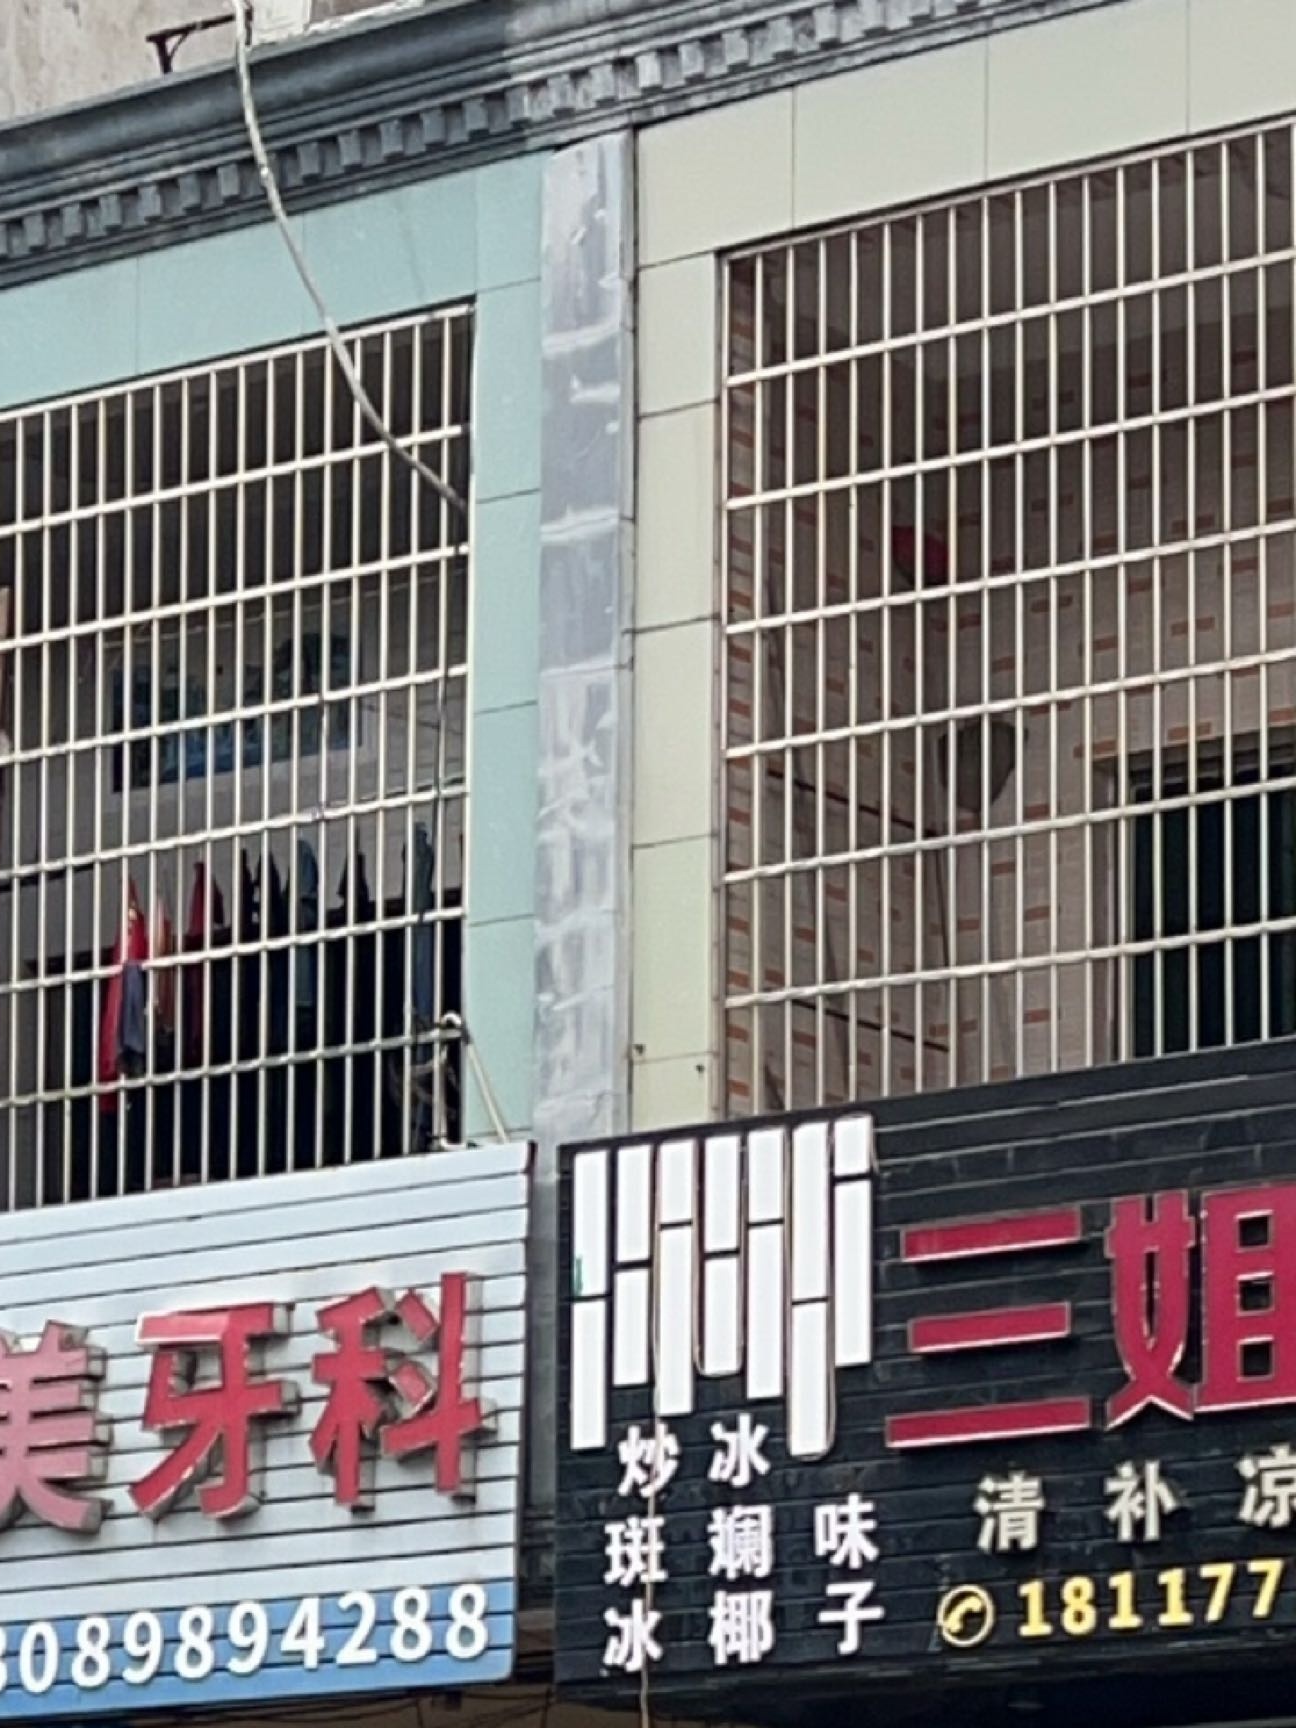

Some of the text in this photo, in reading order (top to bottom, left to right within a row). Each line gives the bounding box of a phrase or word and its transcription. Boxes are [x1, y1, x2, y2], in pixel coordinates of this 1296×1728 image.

[884, 1182, 1296, 1448] 三姐
[617, 1413, 771, 1497] 炒冰
[973, 1442, 1296, 1551] 清补凉
[603, 1492, 879, 1586] 斑斓味
[602, 1580, 885, 1672] 冰椰子
[1018, 1558, 1284, 1637] 181177
